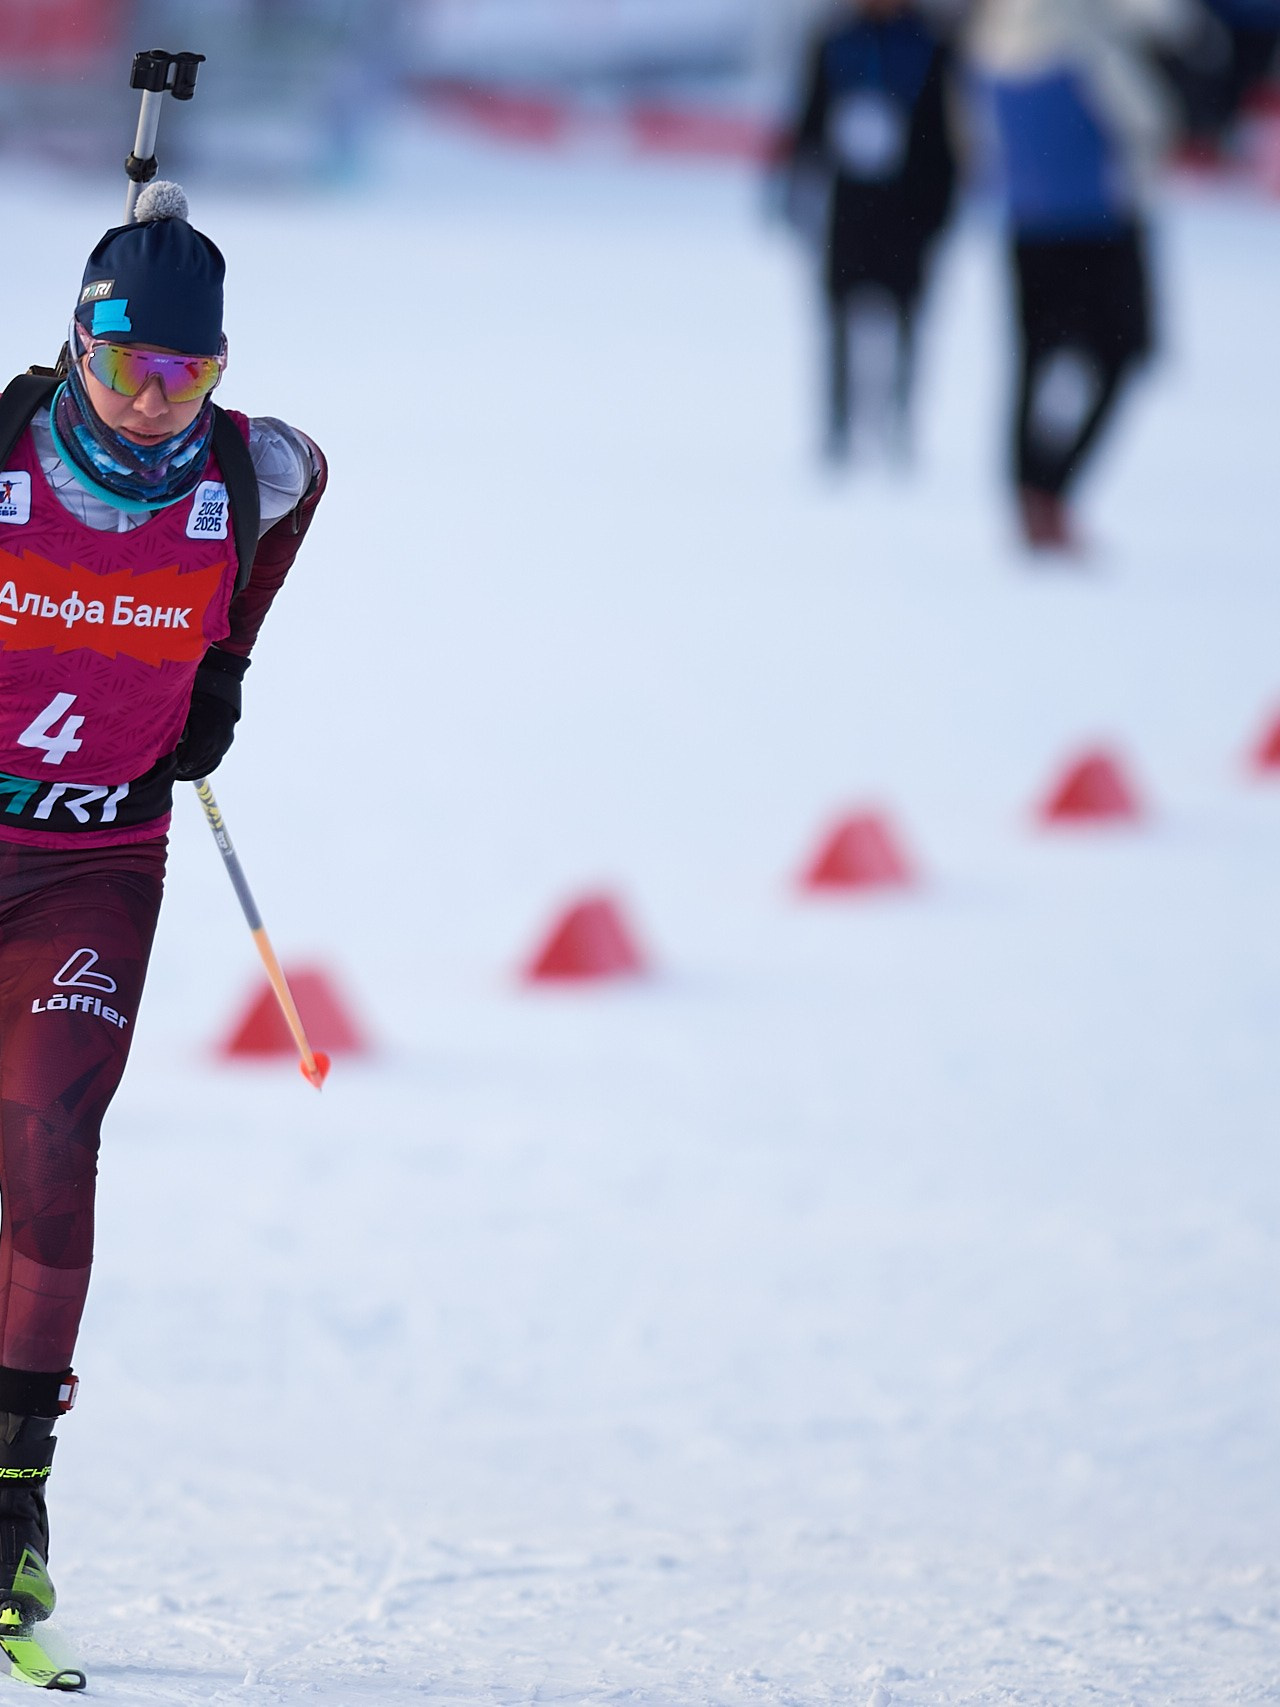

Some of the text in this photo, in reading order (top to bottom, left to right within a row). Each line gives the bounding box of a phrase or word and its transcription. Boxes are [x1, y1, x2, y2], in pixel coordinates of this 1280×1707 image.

[81, 283, 112, 301] PARI
[198, 502, 224, 516] 2024
[193, 517, 222, 532] 2025
[112, 596, 192, 629] Банк
[17, 692, 85, 765] 4
